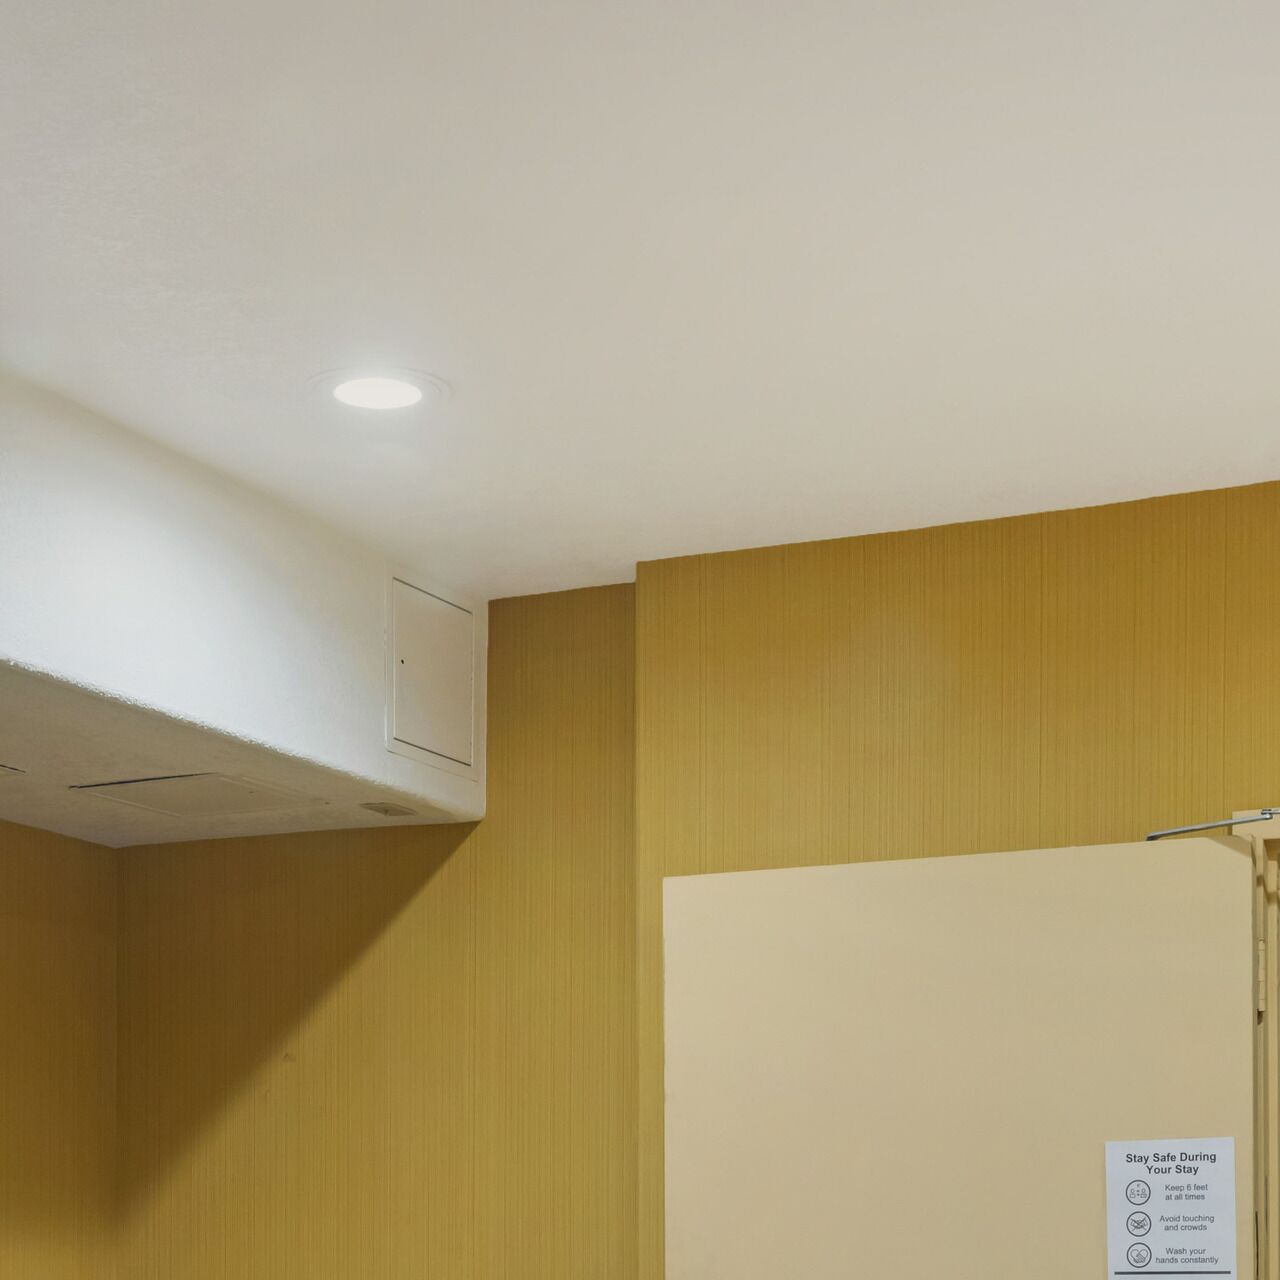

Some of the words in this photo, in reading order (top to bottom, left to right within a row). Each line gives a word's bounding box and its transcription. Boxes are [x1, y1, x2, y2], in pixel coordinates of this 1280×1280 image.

[1125, 1153, 1150, 1165] Stay
[1152, 1153, 1177, 1163] Safe
[1179, 1152, 1217, 1164] During
[1145, 1165, 1172, 1174] Your
[1175, 1164, 1199, 1175] Stay
[1164, 1184, 1185, 1193] Keep
[1193, 1183, 1208, 1191] feet
[1159, 1215, 1181, 1223] Avoid
[1182, 1215, 1215, 1224] touching
[1165, 1247, 1187, 1255] Wash
[1189, 1249, 1206, 1257] your
[1155, 1256, 1179, 1264] hands
[1180, 1256, 1219, 1265] constantly
